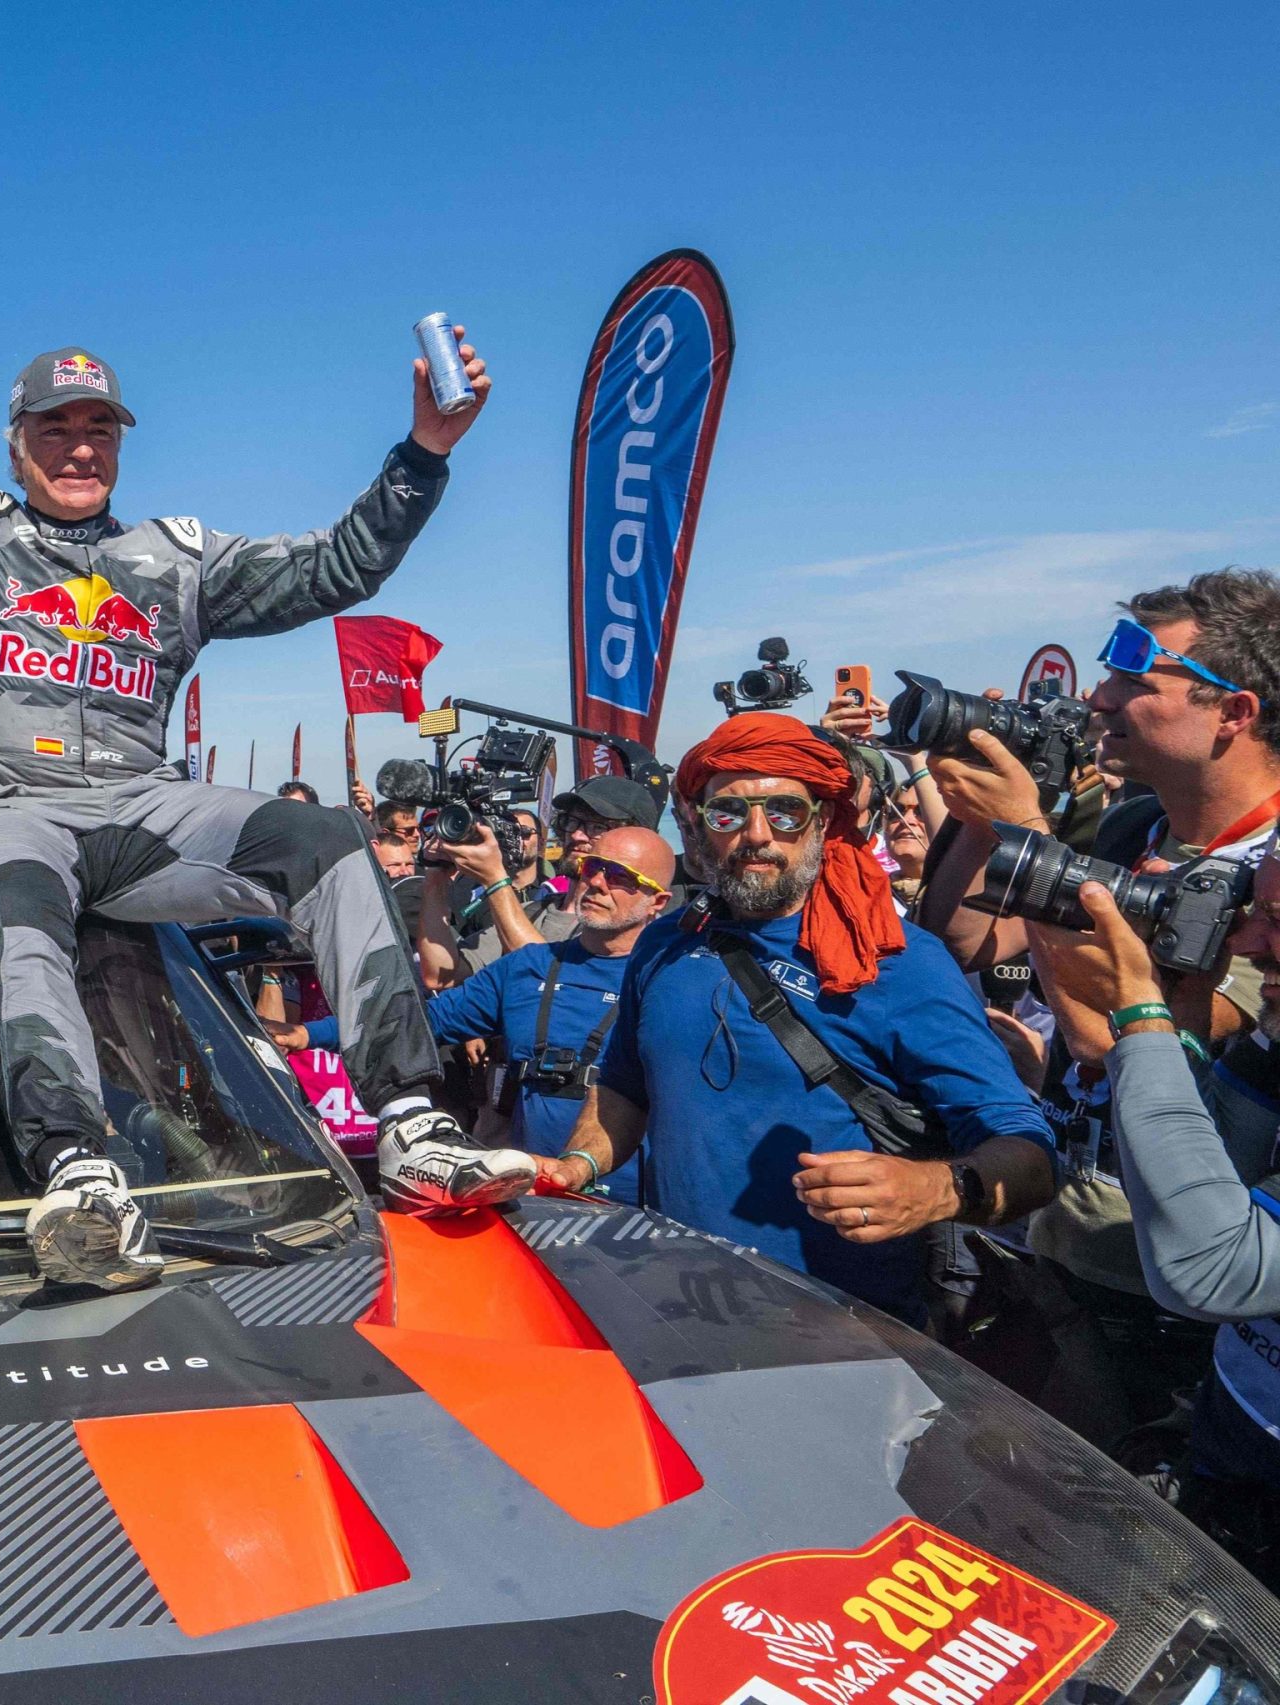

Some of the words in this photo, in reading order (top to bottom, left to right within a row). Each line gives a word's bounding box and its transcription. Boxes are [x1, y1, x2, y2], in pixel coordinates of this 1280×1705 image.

[53, 372, 83, 387] Red
[84, 373, 109, 393] Bull
[599, 312, 674, 681] aramco
[84, 646, 158, 704] Bull
[70, 746, 80, 756] C
[89, 750, 124, 763] SAINZ
[311, 1048, 342, 1075] TV
[841, 1540, 1001, 1653] 2024
[797, 1641, 906, 1705] DAKAR
